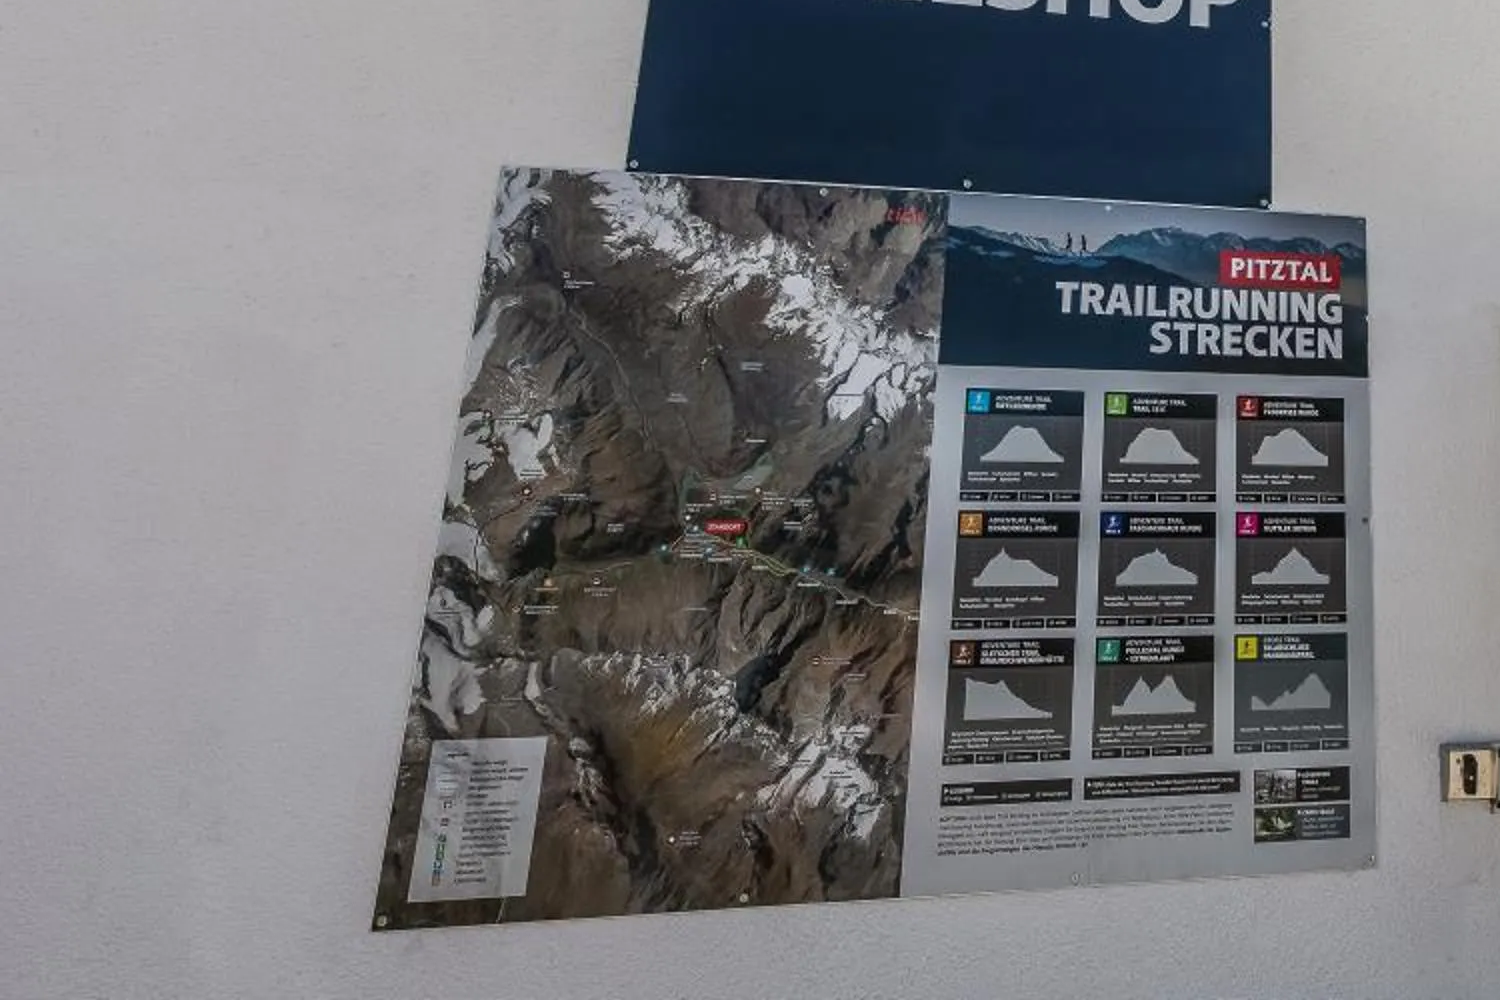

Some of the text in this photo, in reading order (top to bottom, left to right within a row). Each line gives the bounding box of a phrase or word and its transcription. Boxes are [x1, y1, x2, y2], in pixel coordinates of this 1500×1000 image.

[1230, 257, 1334, 284] PITZTAL
[1055, 281, 1344, 325] TRAILRUNNING
[1148, 321, 1344, 360] STRECKEN
